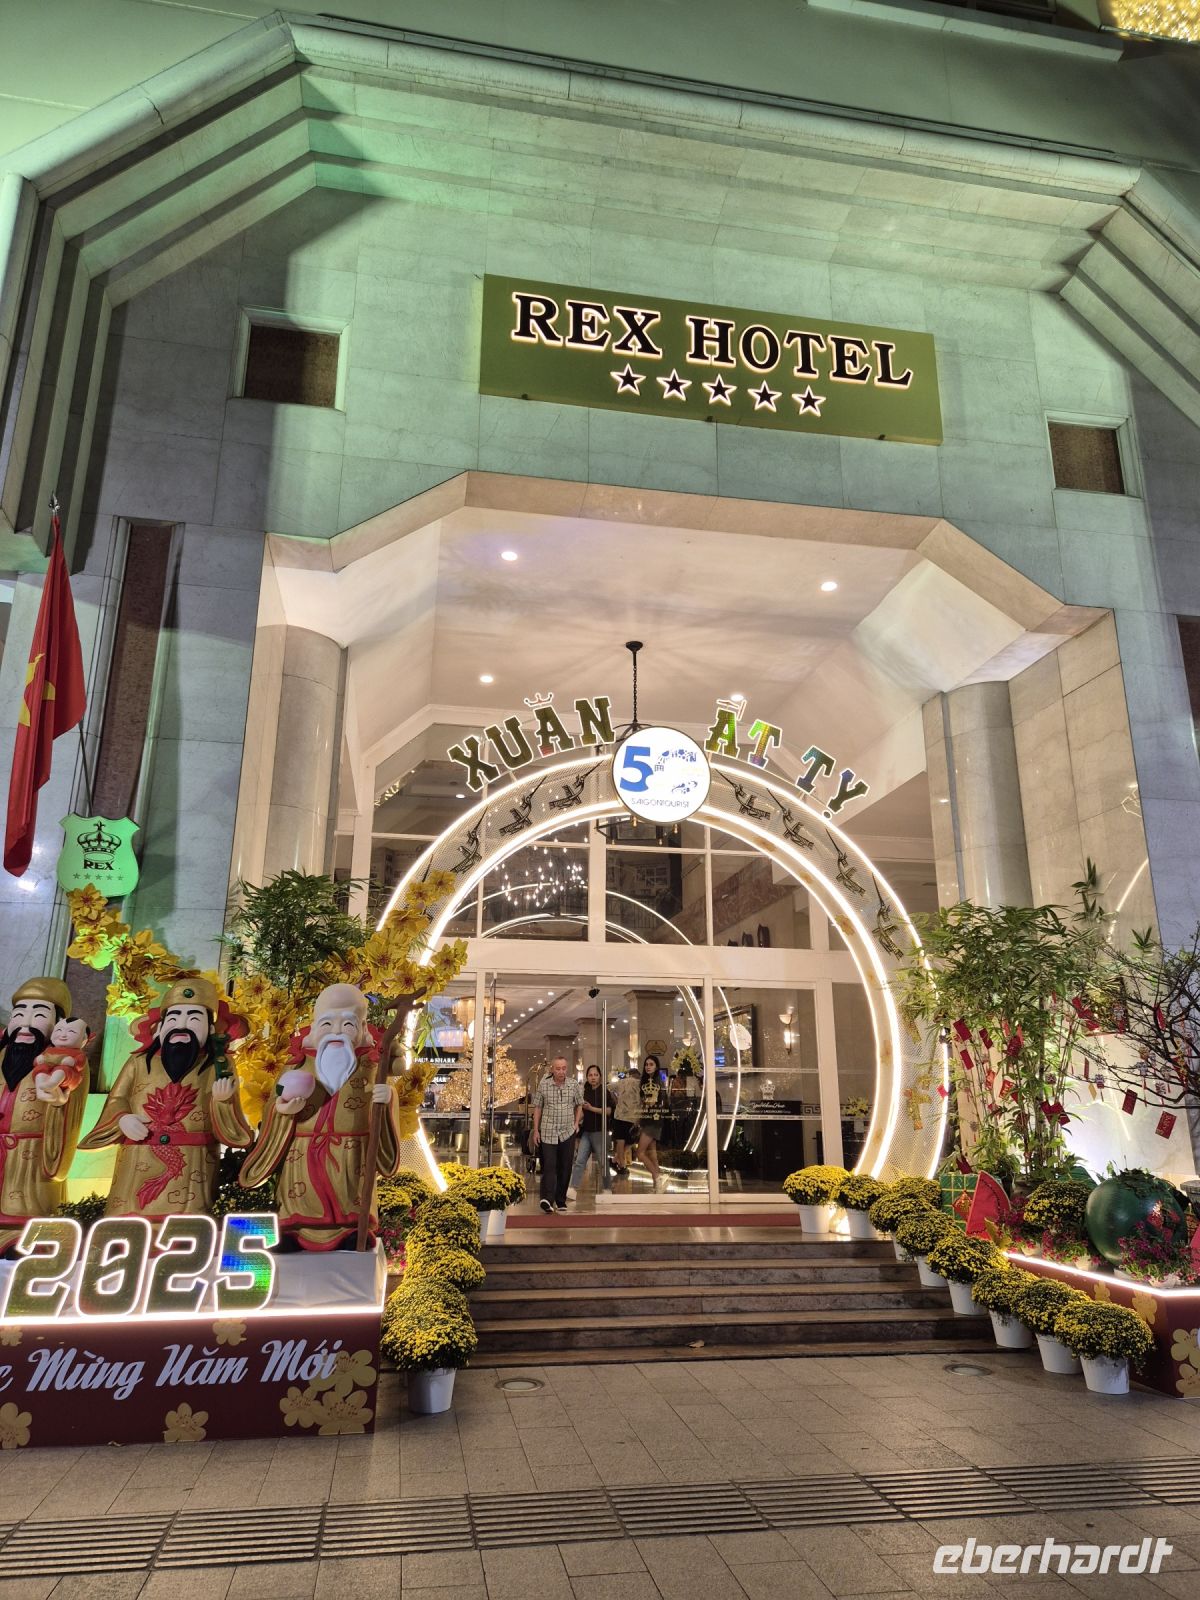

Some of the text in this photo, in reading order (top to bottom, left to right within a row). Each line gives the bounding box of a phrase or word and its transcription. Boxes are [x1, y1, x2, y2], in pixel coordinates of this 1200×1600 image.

[511, 292, 914, 390] REX HOTEL
[83, 860, 114, 870] REX
[2, 1213, 279, 1318] 2025
[26, 1347, 146, 1400] Mừng
[155, 1344, 249, 1387] Năm
[260, 1339, 344, 1382] Mới
